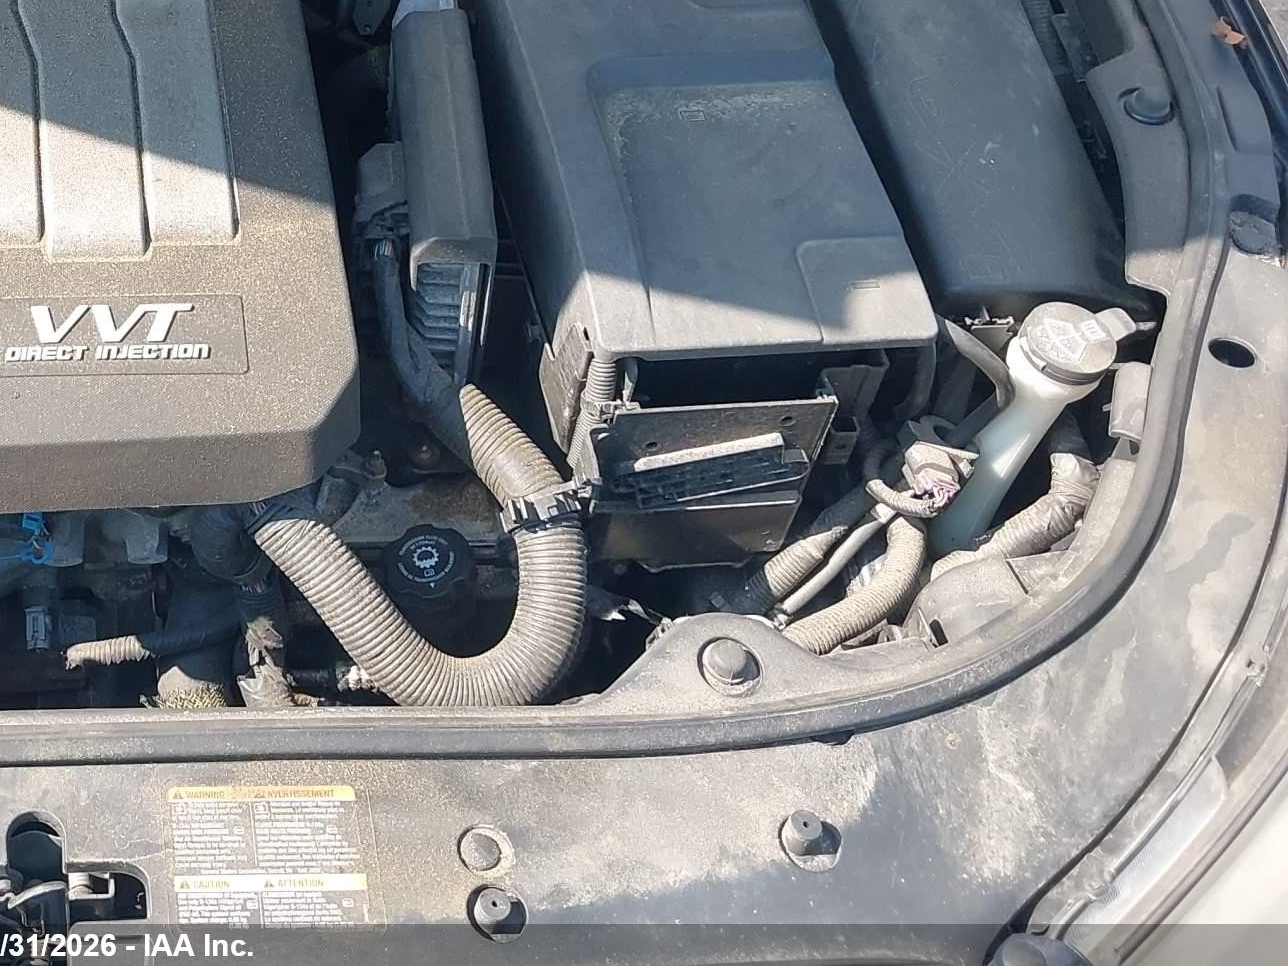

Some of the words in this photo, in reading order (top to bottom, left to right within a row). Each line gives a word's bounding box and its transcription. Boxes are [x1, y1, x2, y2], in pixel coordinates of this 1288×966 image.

[30, 303, 195, 344] VVT
[5, 346, 88, 362] DIRECT
[96, 343, 211, 361] INJECTION
[185, 790, 225, 799] WARNING
[267, 789, 335, 799] AVERTISSEMENT
[193, 880, 230, 889] CAUTION
[277, 879, 324, 889] ATTENTION
